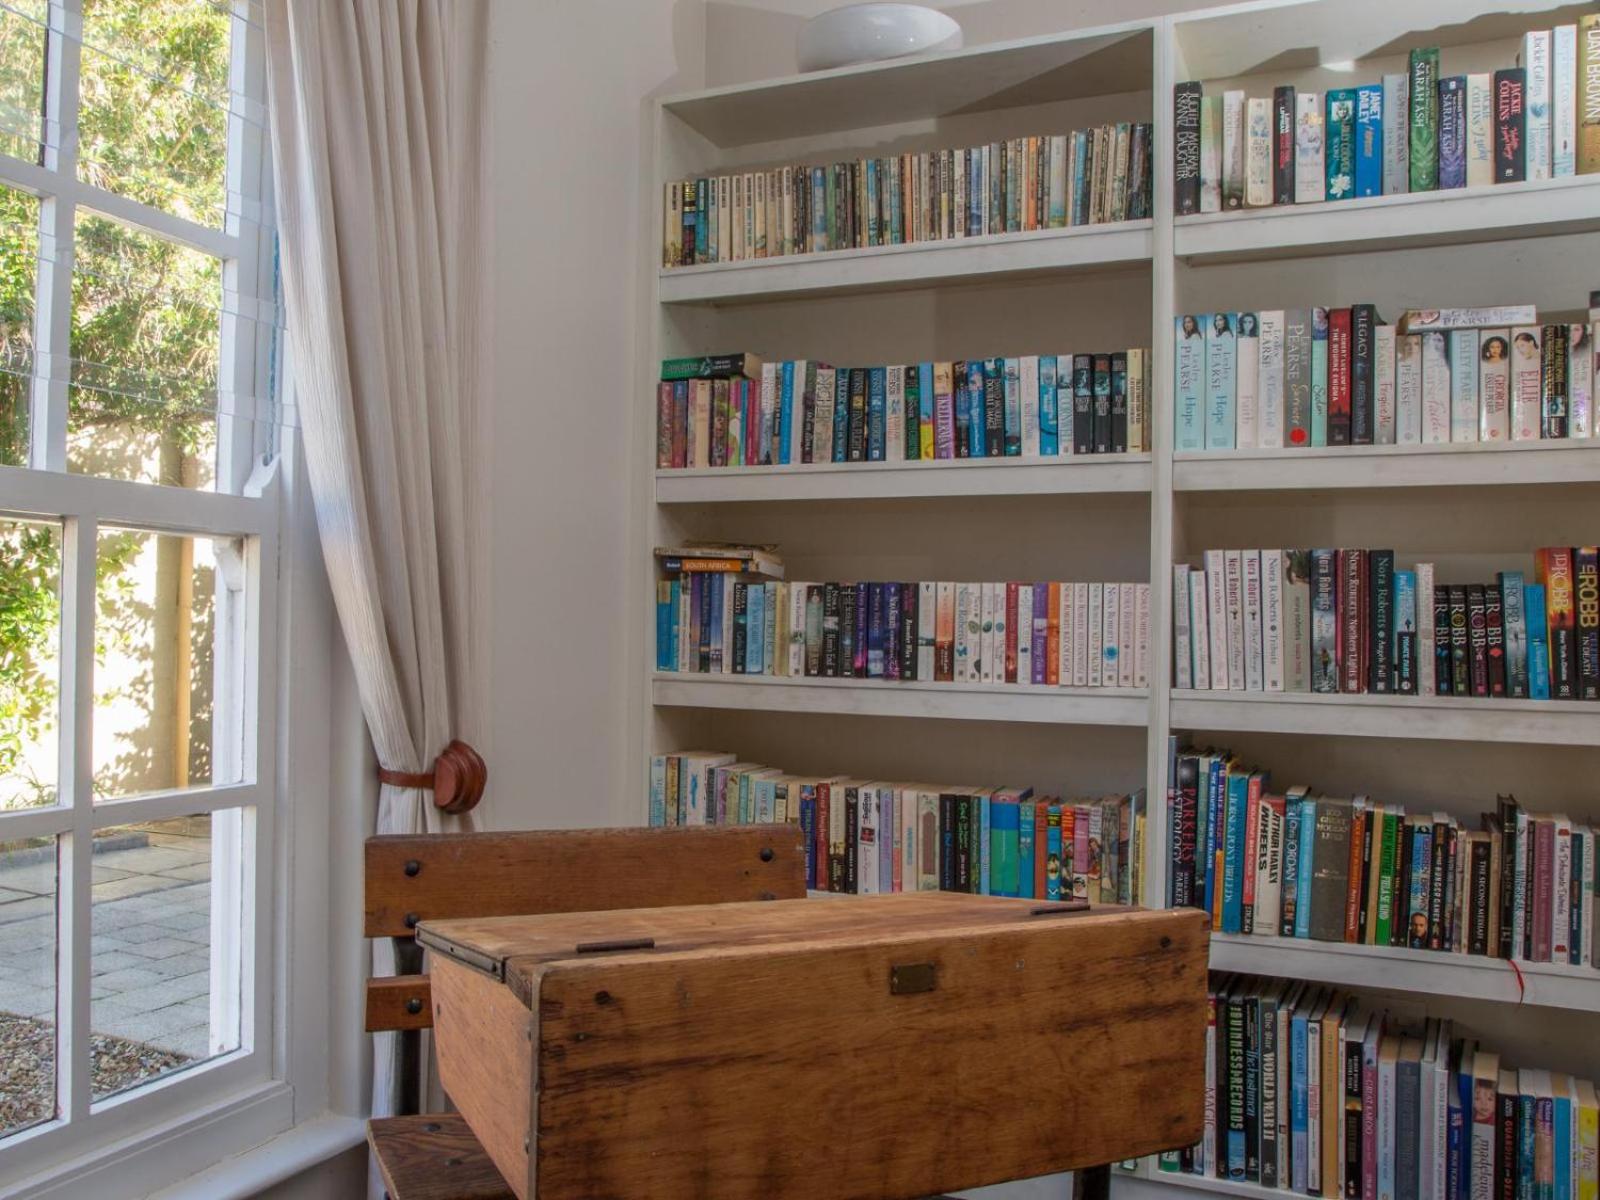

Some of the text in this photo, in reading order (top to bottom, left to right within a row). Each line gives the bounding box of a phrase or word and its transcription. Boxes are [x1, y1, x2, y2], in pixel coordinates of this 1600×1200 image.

[1532, 36, 1546, 97] Jackie Collins
[1585, 29, 1600, 119] DAN BROWN
[1176, 92, 1188, 127] KRANTZ
[1188, 92, 1199, 127] JUDITH
[1359, 90, 1370, 123] DAILEY
[1371, 91, 1381, 120] JANET
[1414, 62, 1426, 127] SARAH ASH
[1472, 86, 1482, 125] COLLINS
[1499, 80, 1510, 120] COLLINS
[1510, 82, 1521, 116] JACKIE
[1442, 94, 1454, 154] SARAH ASH
[1176, 131, 1188, 182] DAUGHTER
[1357, 318, 1368, 358] LEGACY
[1443, 315, 1490, 326] PEARSE
[1262, 321, 1274, 368] PEARSE
[1288, 323, 1304, 381] PEARSE
[1332, 328, 1340, 401] THE BOURNE ENIGMA
[1460, 333, 1473, 367] LESLEY
[1180, 345, 1191, 393] PEARSE
[1210, 343, 1222, 392] PEARSE
[1221, 351, 1232, 381] Lesley
[1401, 364, 1412, 406] PEARSE
[1460, 370, 1473, 402] PEARSE
[1521, 369, 1539, 403] ELLIE
[1181, 396, 1196, 428] Hope
[1211, 394, 1227, 427] Hope
[1494, 374, 1506, 413] GEORGIA
[937, 398, 952, 449] KELLERMAN
[708, 562, 731, 570] AFRICA
[1229, 558, 1241, 606] Nora Roberts
[1247, 558, 1259, 606] Nora Roberts
[1319, 554, 1331, 610] Nora Roberts
[1379, 557, 1389, 585] Nora
[1379, 588, 1389, 628] Roberts
[1506, 586, 1521, 624] ROBB
[1551, 567, 1569, 611] ROBB
[1579, 574, 1598, 628] ROBB
[1269, 557, 1281, 665] Nora Roberts Tribute
[1434, 603, 1448, 646] ROBB
[1451, 603, 1466, 646] ROBB
[1470, 605, 1485, 648] ROBB
[1486, 603, 1502, 646] ROBB
[1349, 618, 1359, 652] Northern
[1347, 654, 1358, 678] Lights
[1379, 664, 1388, 679] Fall
[1583, 647, 1591, 675] DEATH
[1174, 789, 1184, 864] ASTROLOGY
[1229, 793, 1238, 822] HORSE
[1227, 834, 1236, 861] PONY
[1259, 804, 1270, 872] WHEELS
[1268, 811, 1281, 884] ARTHUR HAILEY
[1560, 840, 1571, 853] The
[1286, 839, 1298, 881] JORDAN
[1538, 827, 1551, 899] expecting Adam
[1175, 871, 1185, 905] PARKER
[1225, 863, 1235, 904] BREEDS
[1433, 866, 1442, 922] HUNGER GAMES
[1478, 877, 1488, 908] SECOND
[1476, 909, 1486, 940] MESSIAH
[1264, 1011, 1274, 1030] The
[1230, 1012, 1243, 1130] GUINNESS RECORDS
[1295, 1030, 1305, 1075] west coast
[1263, 1051, 1276, 1099] WORLD
[1205, 1087, 1216, 1130] MAGIC
[1263, 1100, 1275, 1127] WAR
[1365, 1079, 1374, 1135] GREAT KAROO
[1263, 1129, 1275, 1141] II
[1504, 1120, 1513, 1168] GUARDIAN
[1479, 1138, 1493, 1200] madeleine
